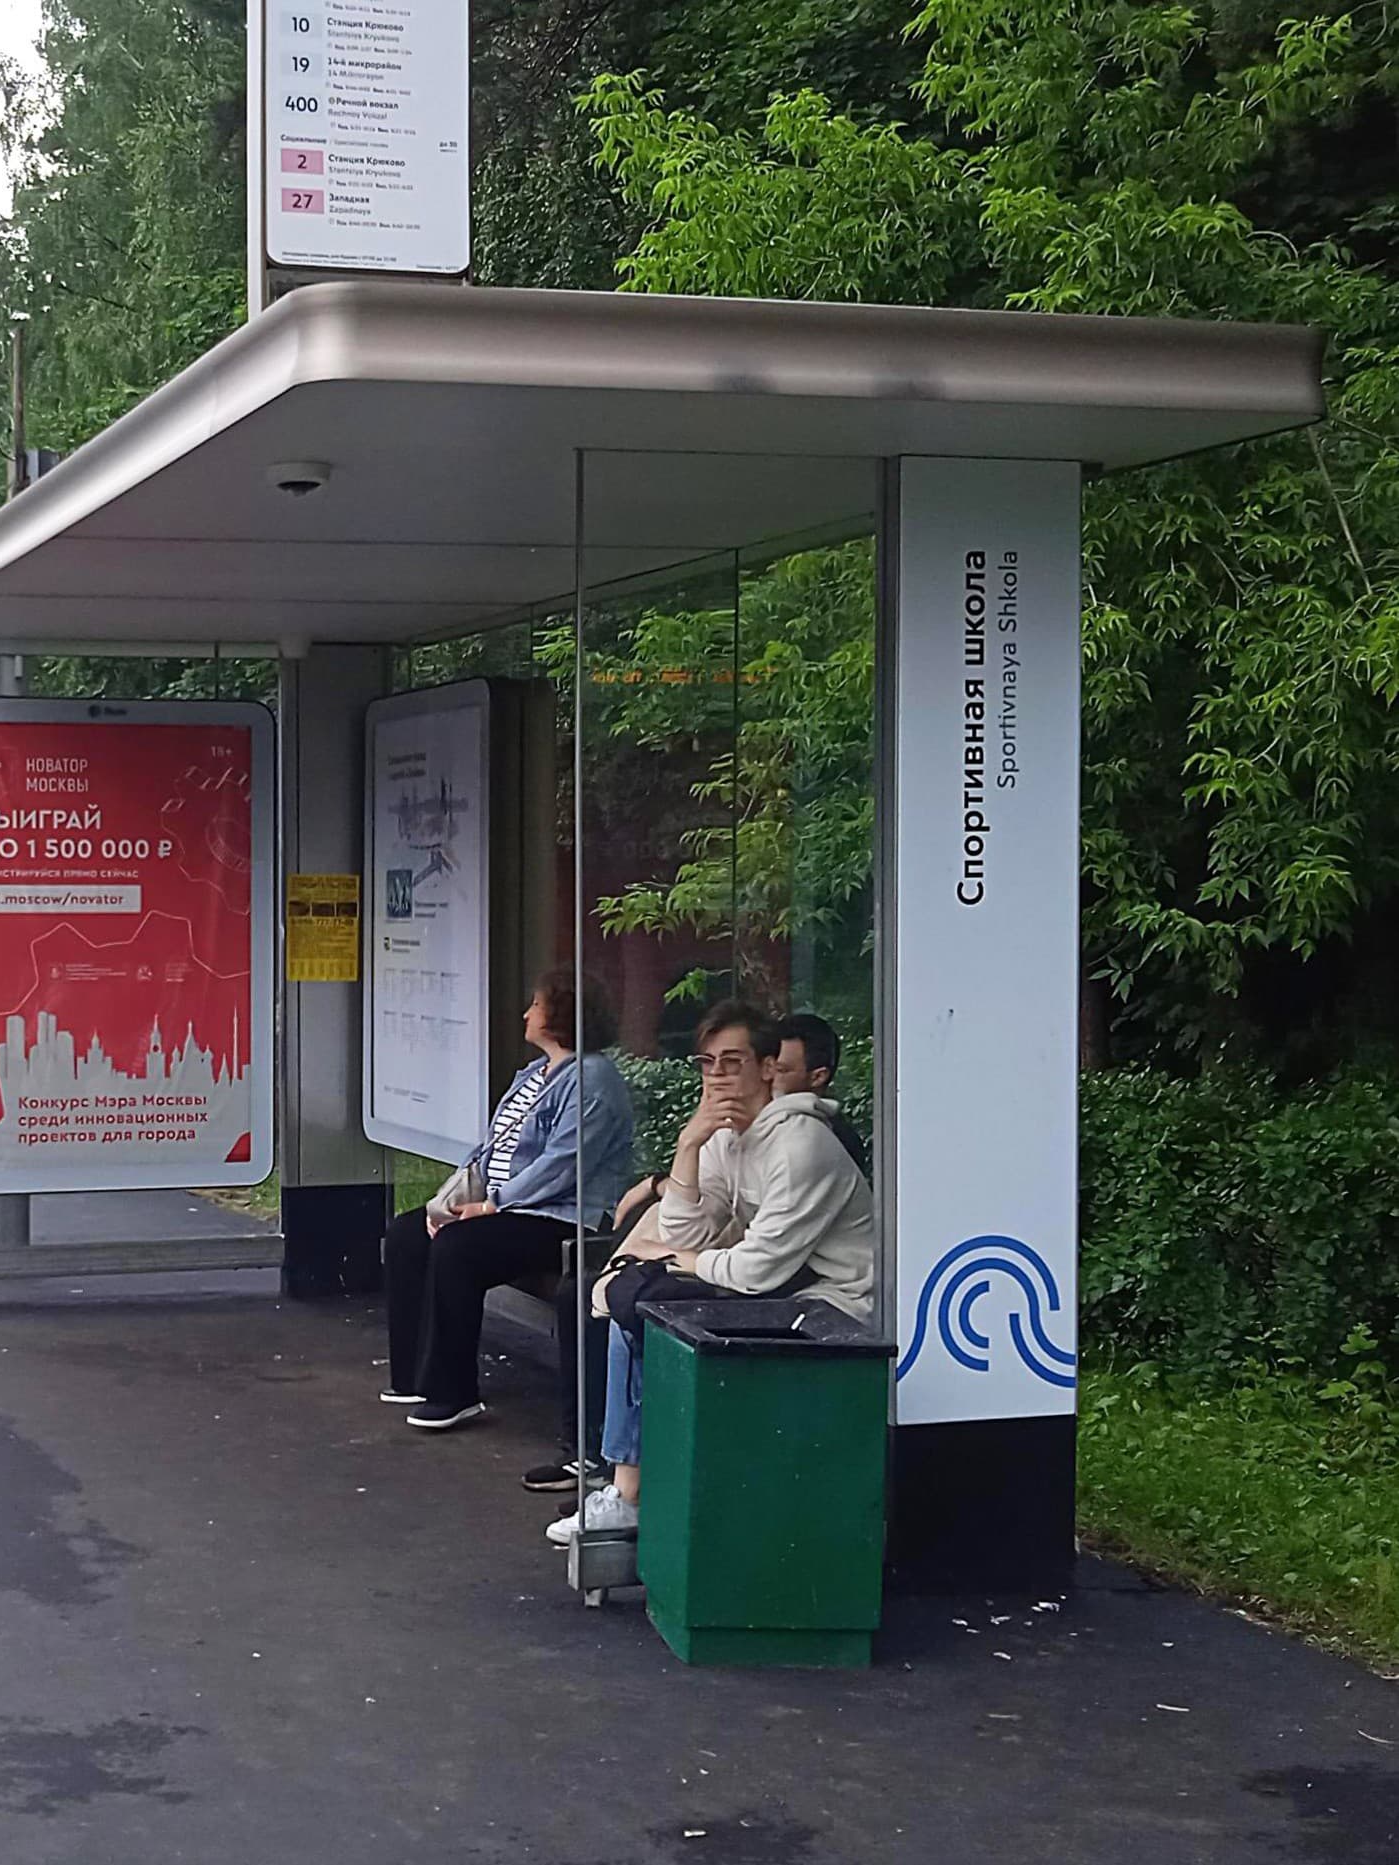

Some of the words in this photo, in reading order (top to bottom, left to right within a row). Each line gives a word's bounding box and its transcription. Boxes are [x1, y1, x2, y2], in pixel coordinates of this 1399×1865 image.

[291, 16, 310, 33] 10
[327, 17, 363, 29] Станция
[365, 20, 404, 32] Крюково
[291, 56, 310, 72] 19
[348, 59, 402, 71] микрорайон
[285, 96, 318, 113] 400
[336, 97, 367, 108] Речной
[369, 101, 399, 110] вокзал
[297, 154, 308, 170] 2
[328, 154, 364, 165] Станция
[366, 156, 406, 168] Крюково
[292, 193, 313, 209] 27
[329, 193, 370, 204] Западная
[997, 550, 1018, 633] Shkola
[963, 550, 987, 667] школа
[997, 641, 1021, 789] Sportivnaya
[25, 758, 89, 773] НОВАТОР
[25, 778, 89, 793] МОСКВЫ
[956, 678, 991, 906] Спортивная
[27, 840, 36, 858] 1
[44, 839, 92, 859] 500
[101, 839, 150, 859] 000
[63, 869, 98, 878] ПРЯМО
[100, 868, 139, 878] СЕЙЧАС
[18, 1096, 89, 1113] Конкурс
[95, 1096, 137, 1111] Мэра
[142, 1094, 207, 1107] Москвы
[18, 1115, 69, 1128] среди
[75, 1112, 208, 1126] инновационных
[18, 1132, 97, 1146] проектов
[102, 1132, 133, 1144] для
[138, 1129, 196, 1143] города
